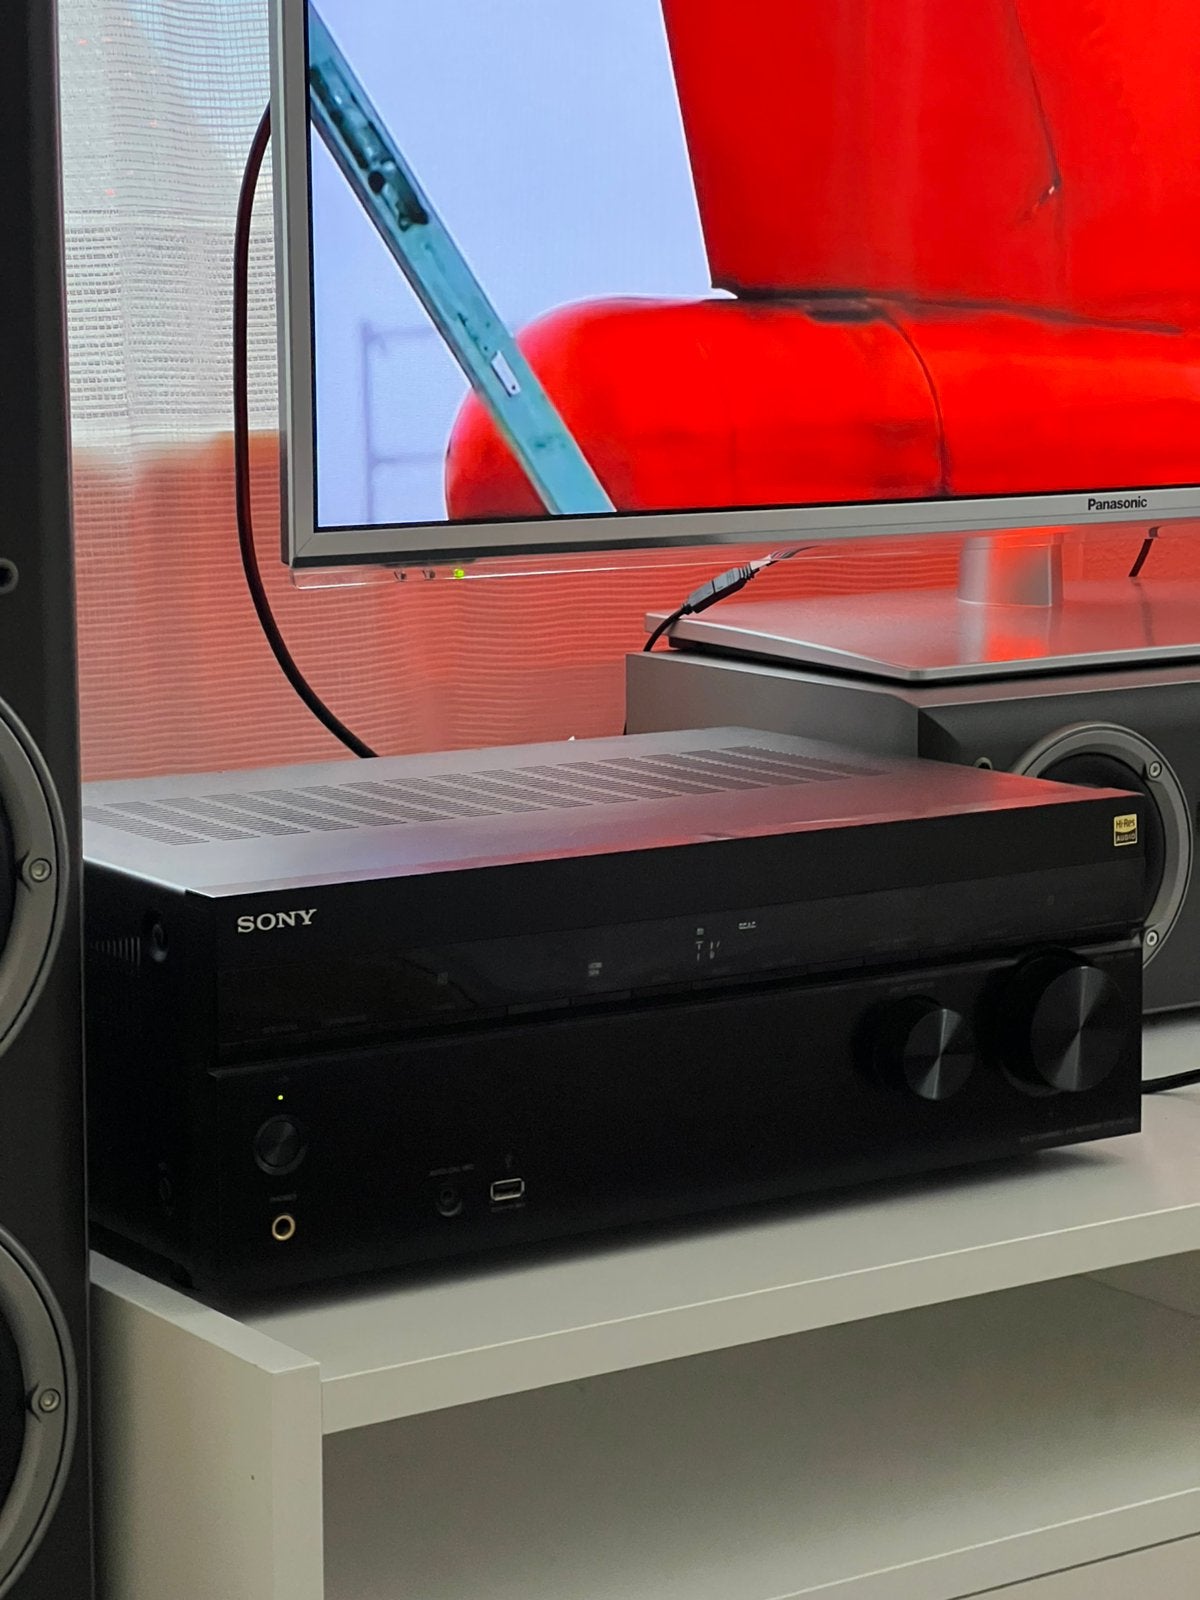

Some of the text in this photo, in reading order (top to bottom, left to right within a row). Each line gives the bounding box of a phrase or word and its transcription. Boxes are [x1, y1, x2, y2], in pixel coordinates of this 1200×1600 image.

[1087, 495, 1148, 511] Panasonic
[1116, 832, 1136, 841] AUDIO
[237, 908, 318, 933] SONY
